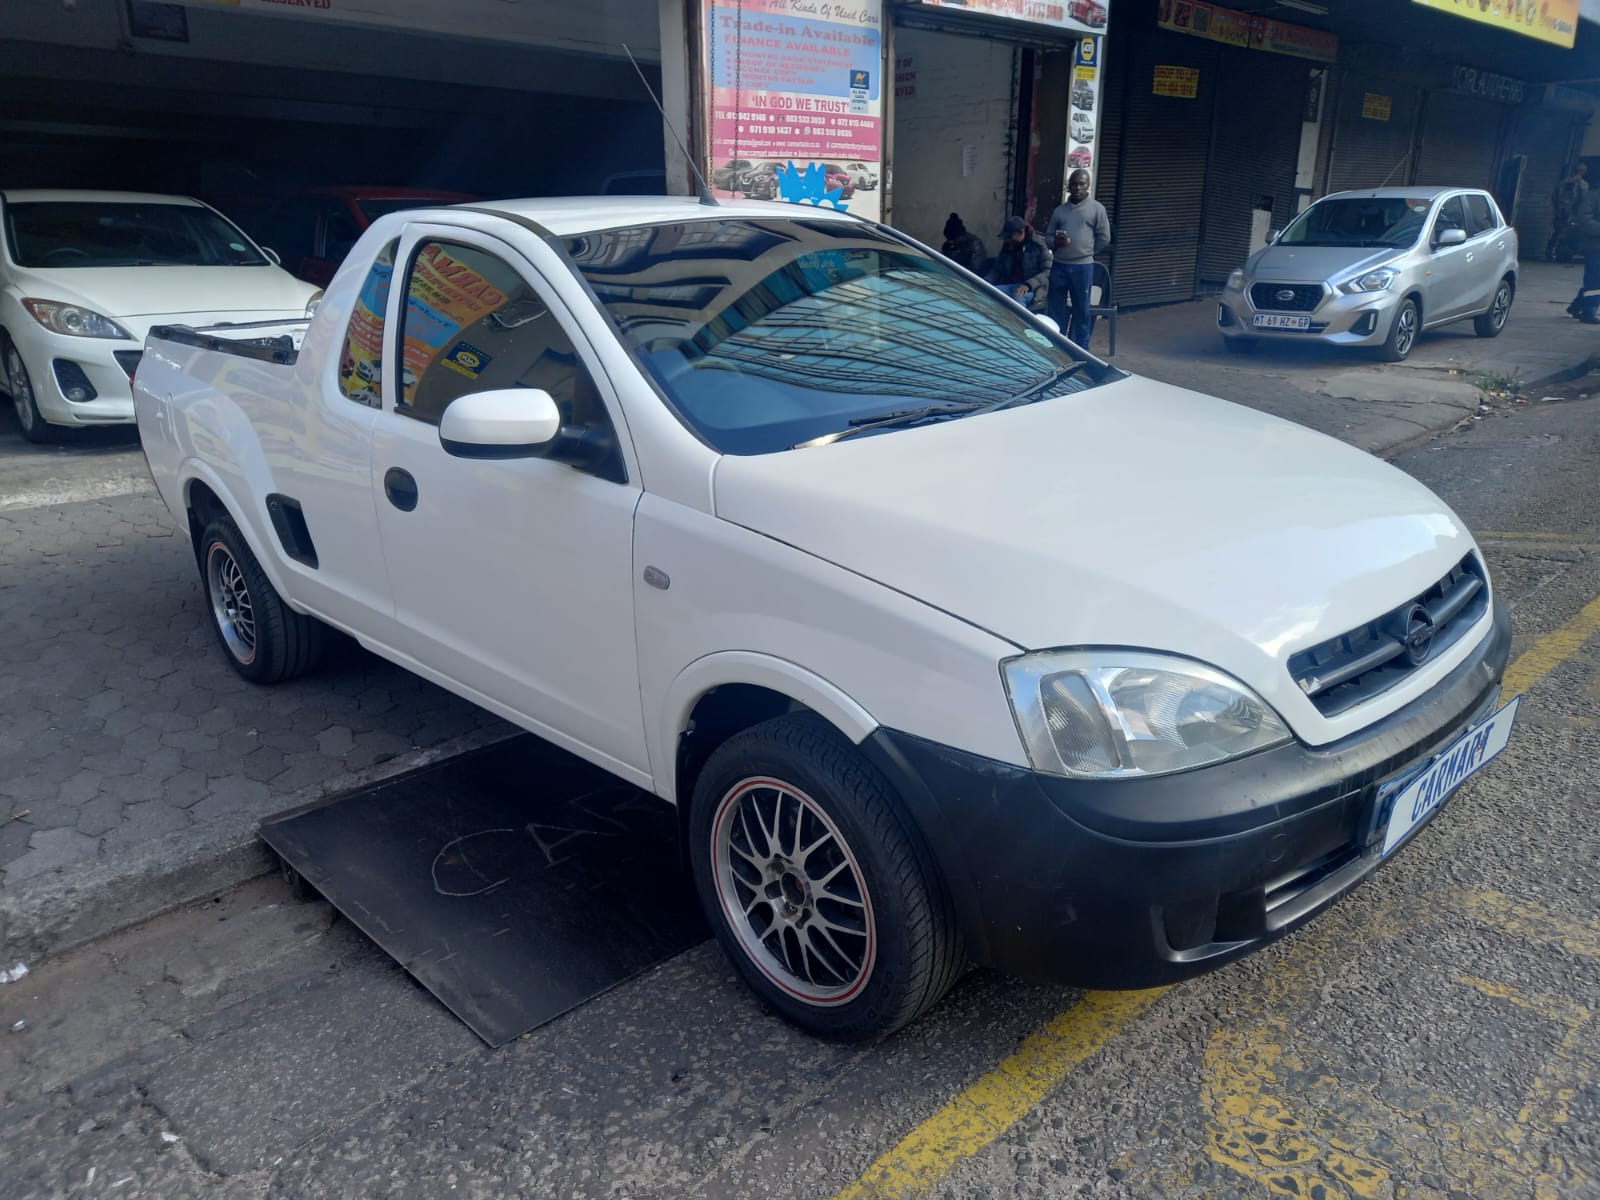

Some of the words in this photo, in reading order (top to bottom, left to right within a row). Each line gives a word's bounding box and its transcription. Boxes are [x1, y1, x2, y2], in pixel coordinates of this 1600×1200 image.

[790, 0, 818, 14] Kinds
[820, 4, 832, 20] Of
[834, 6, 857, 21] Used
[858, 9, 879, 24] Cars
[720, 15, 796, 36] Trade-in
[801, 26, 876, 47] Available
[724, 34, 782, 49] FINANCE
[786, 41, 852, 57] AVAILABLE
[770, 96, 792, 109] GOD
[795, 98, 811, 110] WE
[1280, 316, 1291, 327] HZ
[1298, 318, 1309, 328] GP
[1411, 722, 1496, 822] CARMART
